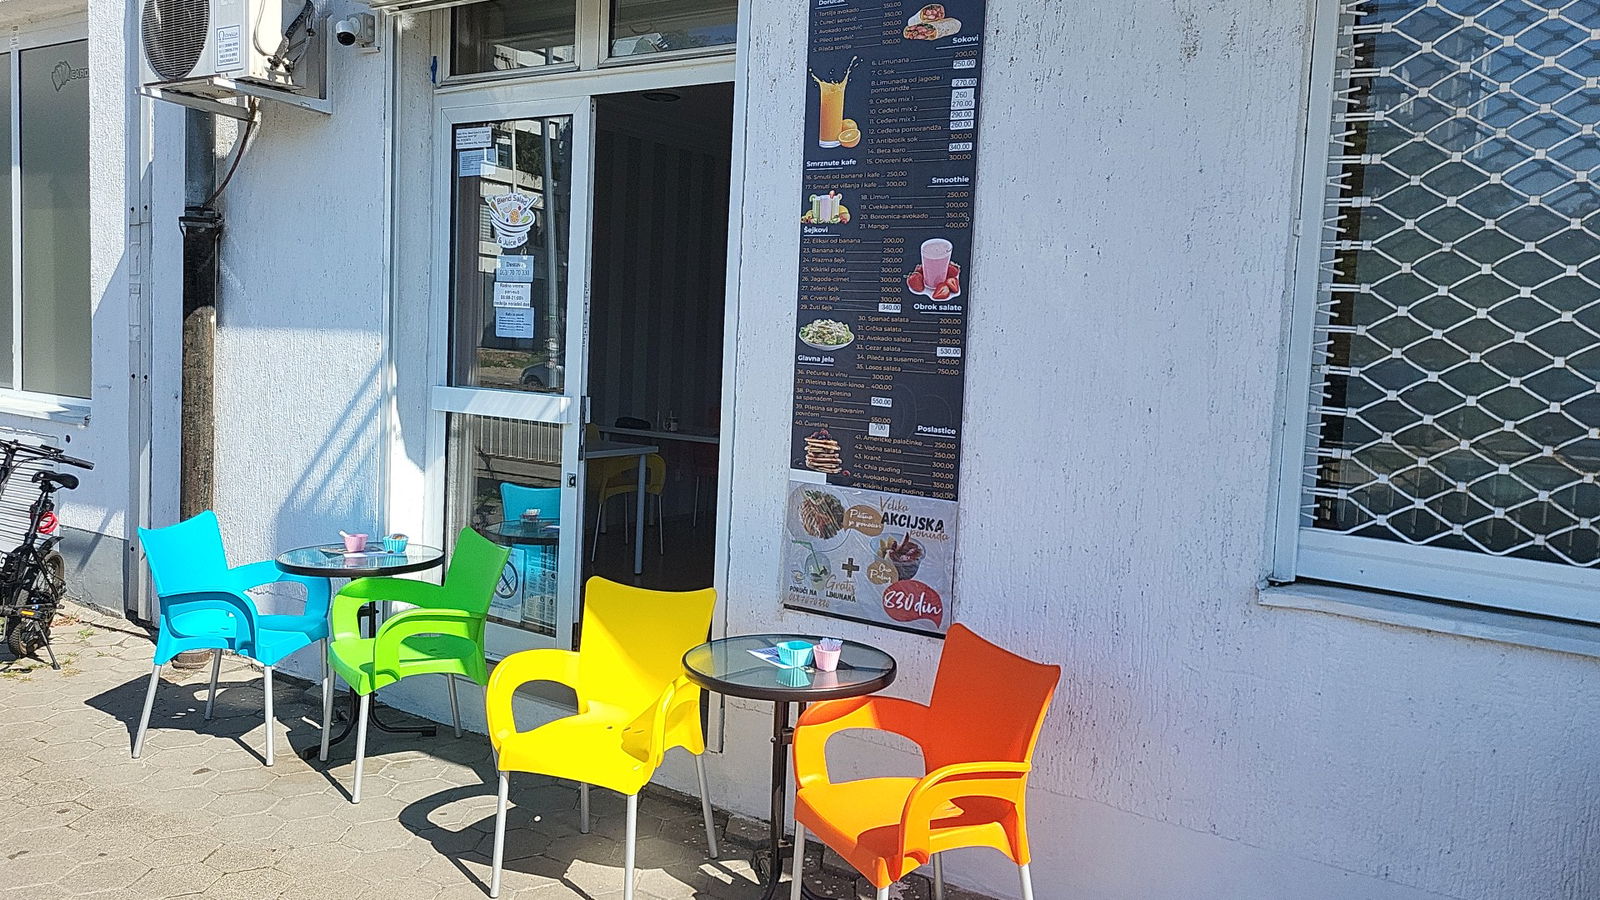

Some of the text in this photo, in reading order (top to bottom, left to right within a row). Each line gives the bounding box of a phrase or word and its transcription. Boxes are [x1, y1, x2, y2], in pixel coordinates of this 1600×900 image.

[953, 35, 979, 43] Sokovi
[513, 195, 527, 205] Salad
[517, 234, 526, 243] Bar
[918, 425, 956, 434] Poslastice
[879, 466, 901, 474] puding
[863, 473, 888, 481] Avokado
[890, 477, 912, 485] puding
[902, 488, 924, 496] puding
[880, 496, 909, 512] Velika
[881, 512, 944, 533] AKCIJSKA
[826, 591, 856, 602] LIMUNANA
